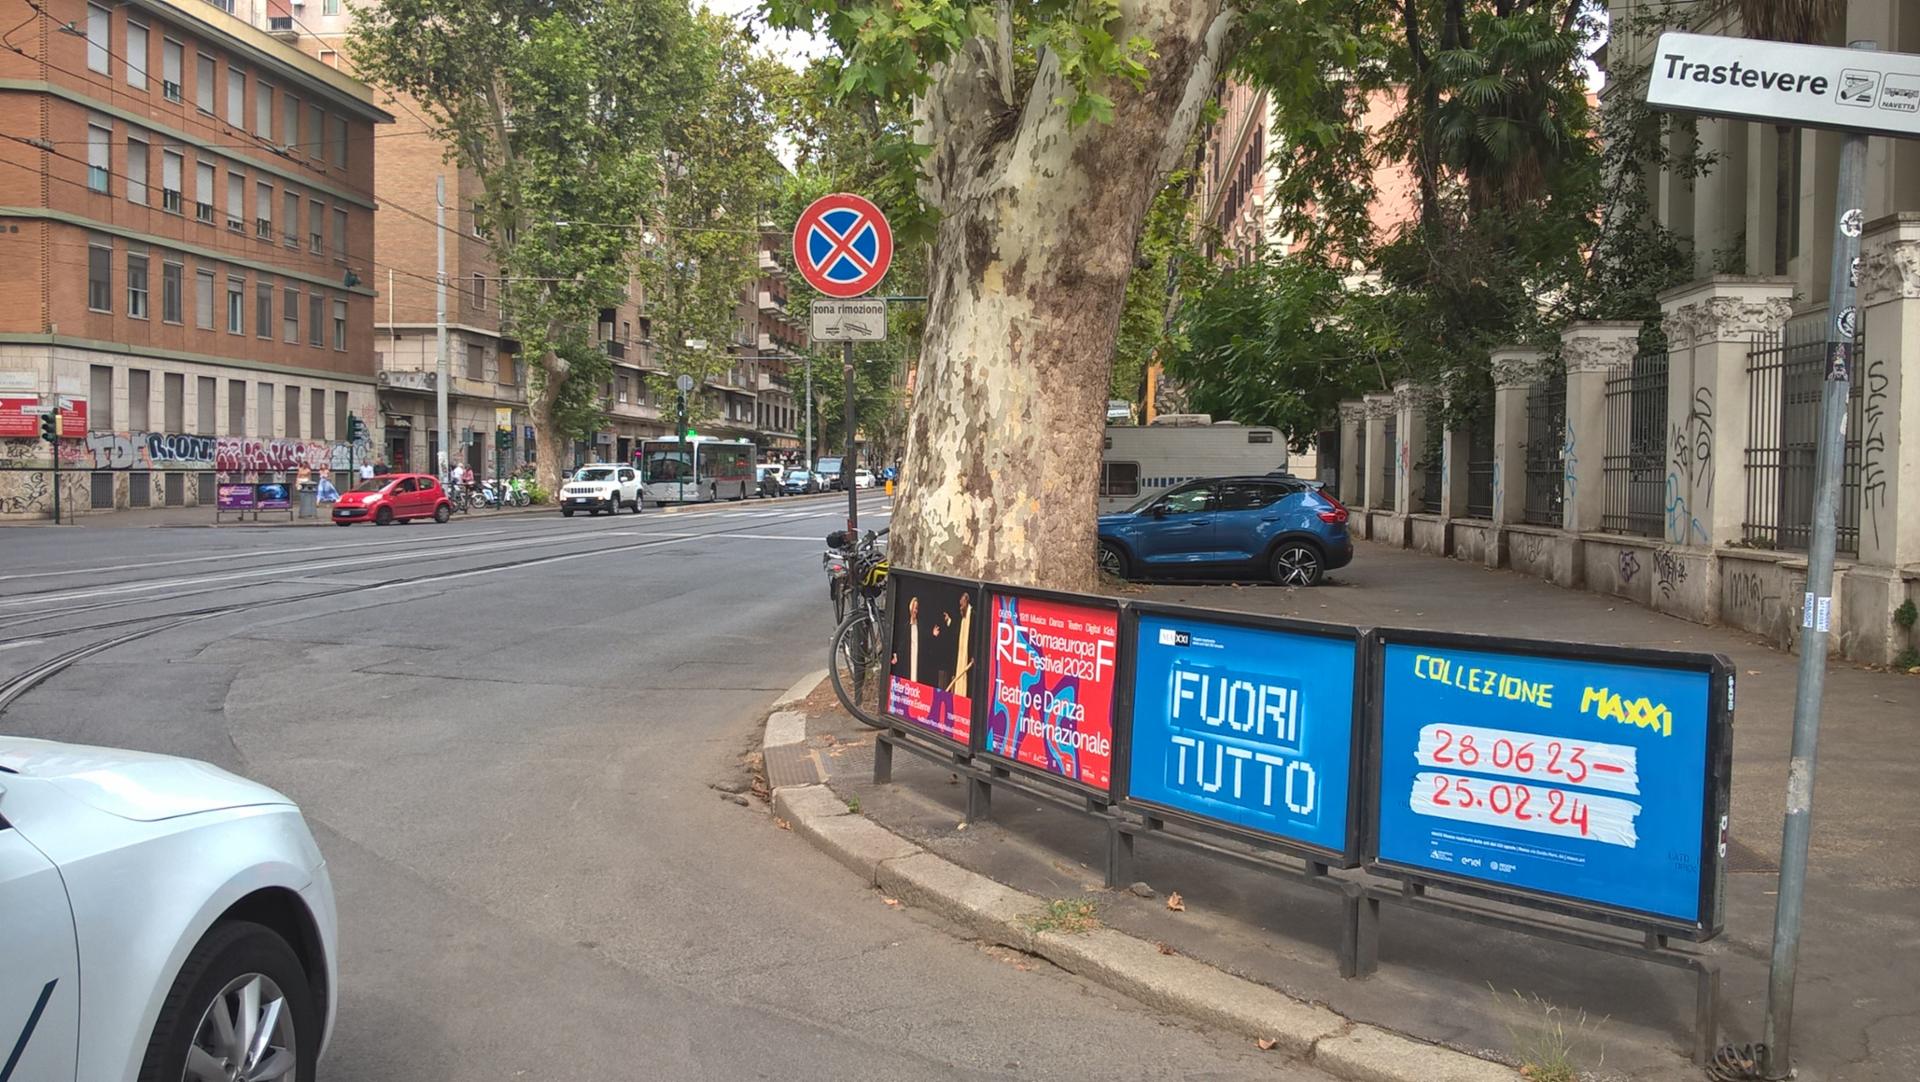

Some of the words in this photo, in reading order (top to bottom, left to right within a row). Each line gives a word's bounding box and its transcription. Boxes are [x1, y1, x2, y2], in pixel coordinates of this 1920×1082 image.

[1664, 54, 1829, 95] Trastevere
[1882, 101, 1915, 110] NAVETTA
[814, 305, 835, 314] zona
[837, 304, 883, 314] rimozione
[996, 622, 1029, 667] RE
[1028, 628, 1095, 658] Romaeuropa
[1030, 613, 1047, 625] Musica
[1048, 617, 1065, 628] Danza
[1067, 620, 1083, 631] Teatro
[1085, 623, 1101, 635] Digital
[1027, 651, 1063, 675] Festival
[1064, 658, 1095, 681] 2023
[1095, 640, 1114, 682] F
[996, 679, 1031, 709] Teatro
[1033, 693, 1042, 710] e
[1044, 691, 1085, 722] Danza
[1172, 670, 1298, 742] FUORI
[1414, 654, 1554, 709] COLLEZIONE
[1580, 686, 1673, 737] MAXXI
[1171, 735, 1316, 816] TUTTO
[1431, 775, 1589, 837] 25.02.24
[1461, 856, 1481, 867] enel
